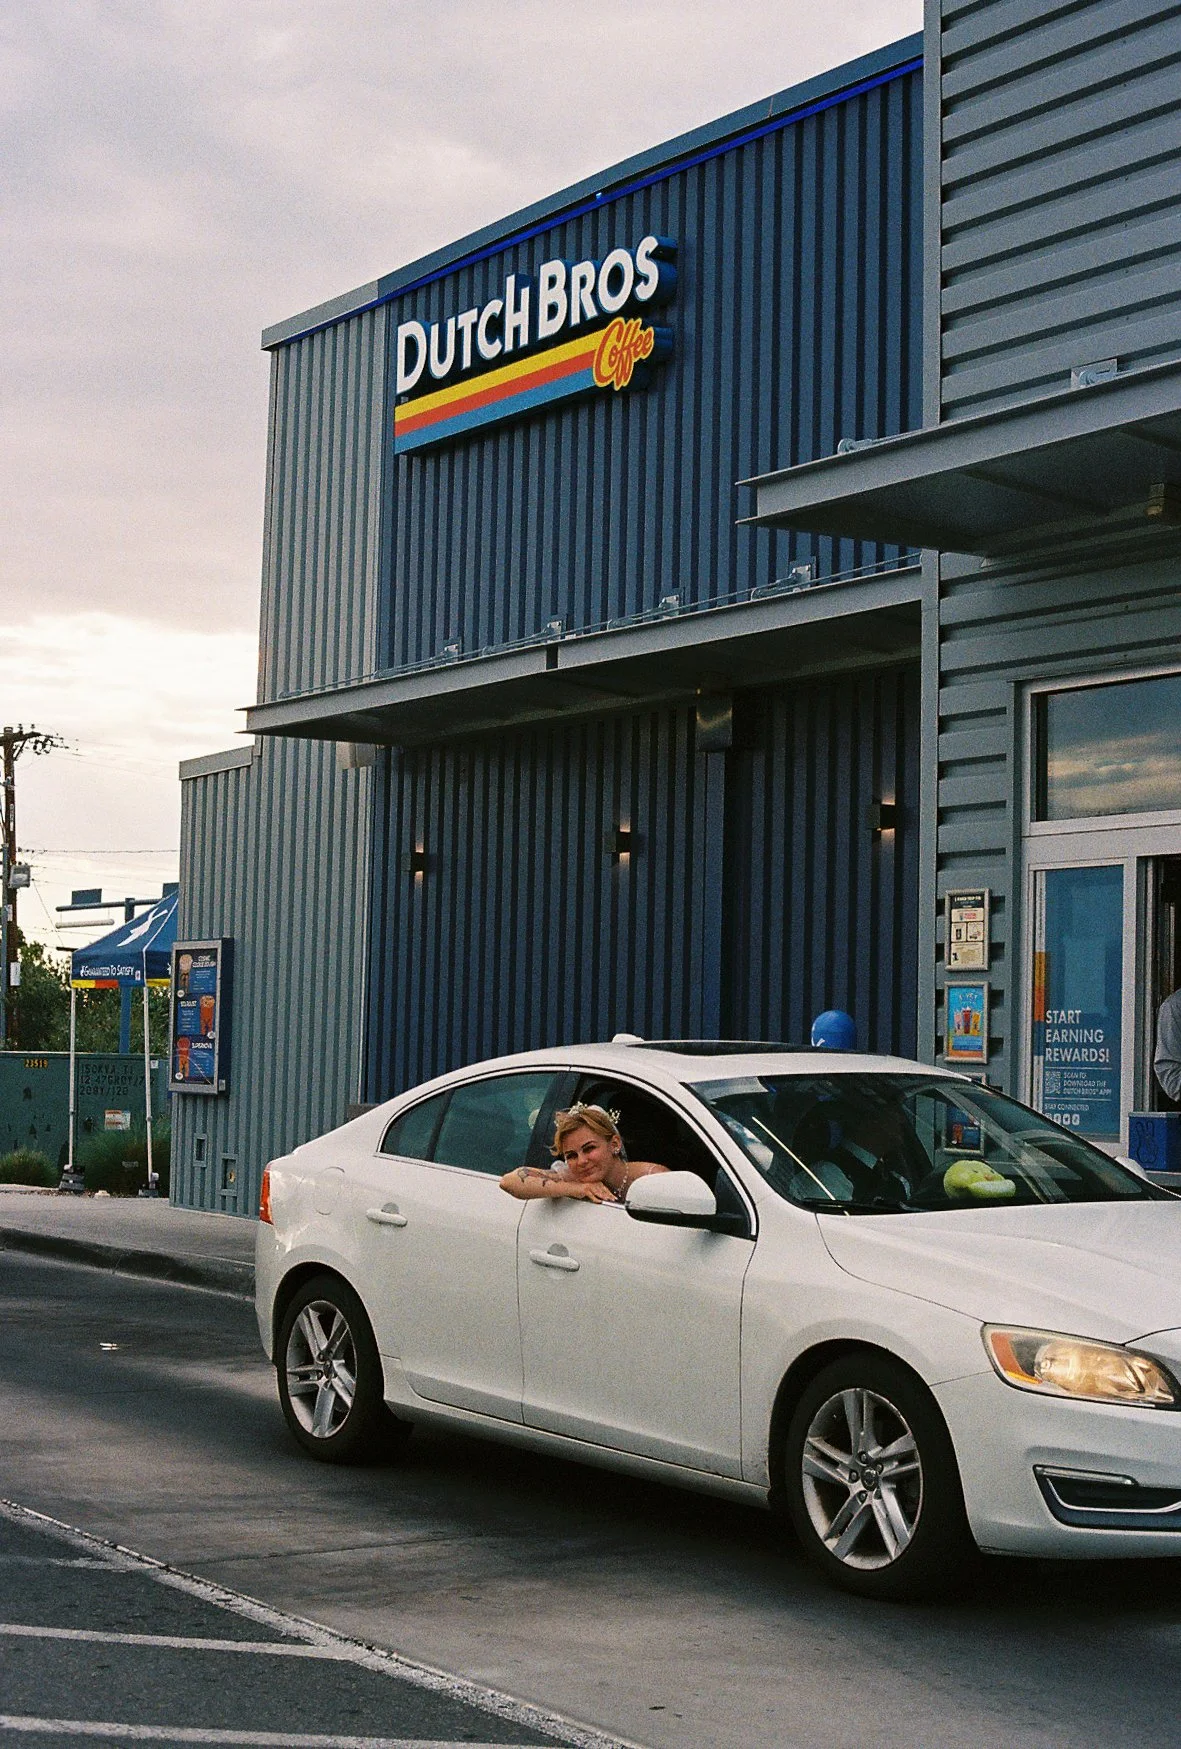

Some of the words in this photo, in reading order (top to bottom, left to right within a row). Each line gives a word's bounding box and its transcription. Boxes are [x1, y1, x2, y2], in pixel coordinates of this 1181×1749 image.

[396, 274, 530, 395] DUTCH
[537, 236, 659, 341] BROS
[594, 317, 654, 390] Coffee
[1045, 1009, 1082, 1024] START
[1045, 1029, 1104, 1043] EARNING
[1045, 1047, 1110, 1063] REWARDS!
